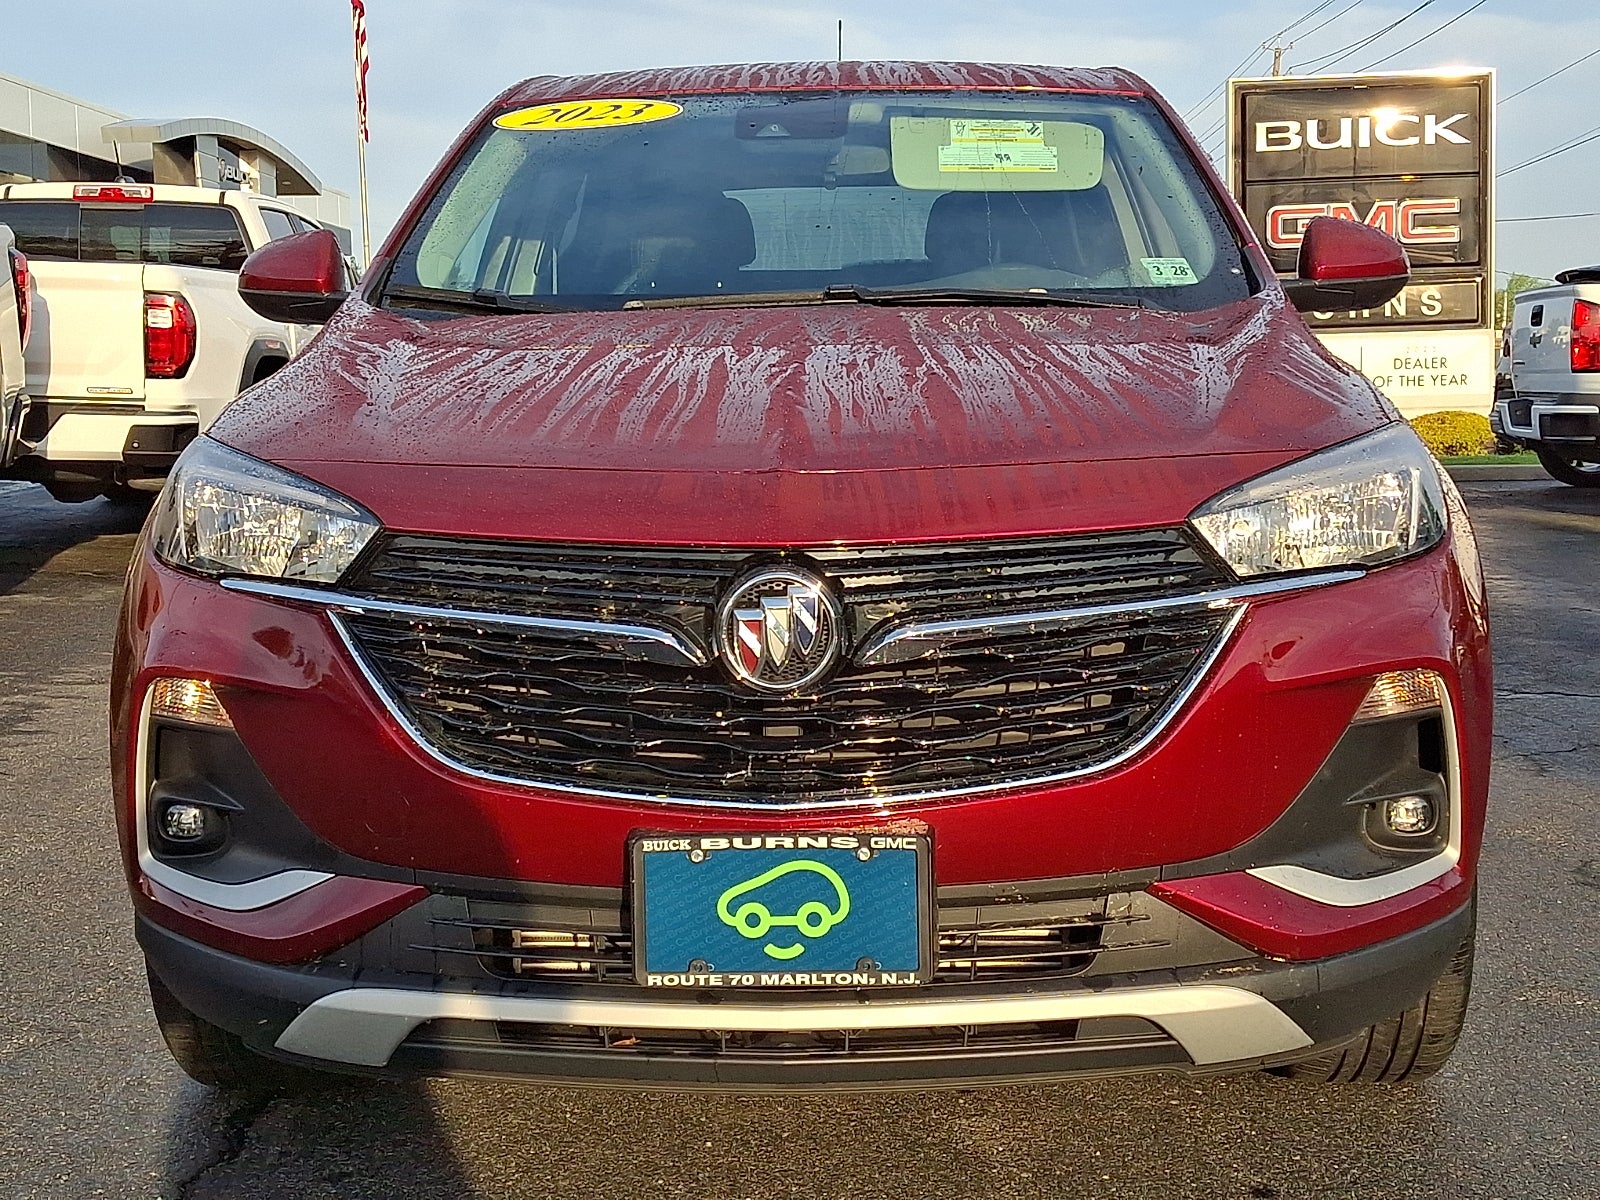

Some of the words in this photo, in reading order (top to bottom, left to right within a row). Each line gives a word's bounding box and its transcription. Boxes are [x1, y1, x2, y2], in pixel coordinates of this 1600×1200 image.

[521, 104, 654, 126] 2023
[1255, 113, 1471, 152] BUICK
[1266, 198, 1461, 249] GMC
[1152, 265, 1163, 276] 3
[1393, 356, 1448, 370] DEALER
[1372, 375, 1393, 388] OF
[1398, 374, 1425, 387] THE
[1430, 373, 1468, 386] YEAR
[642, 839, 692, 852] BUICK
[700, 836, 860, 849] BURNS
[870, 836, 917, 849] GMC
[647, 975, 723, 986] ROUTE
[728, 974, 755, 986] 70
[760, 973, 876, 985] MARLTON,
[881, 972, 921, 985] N.J.
